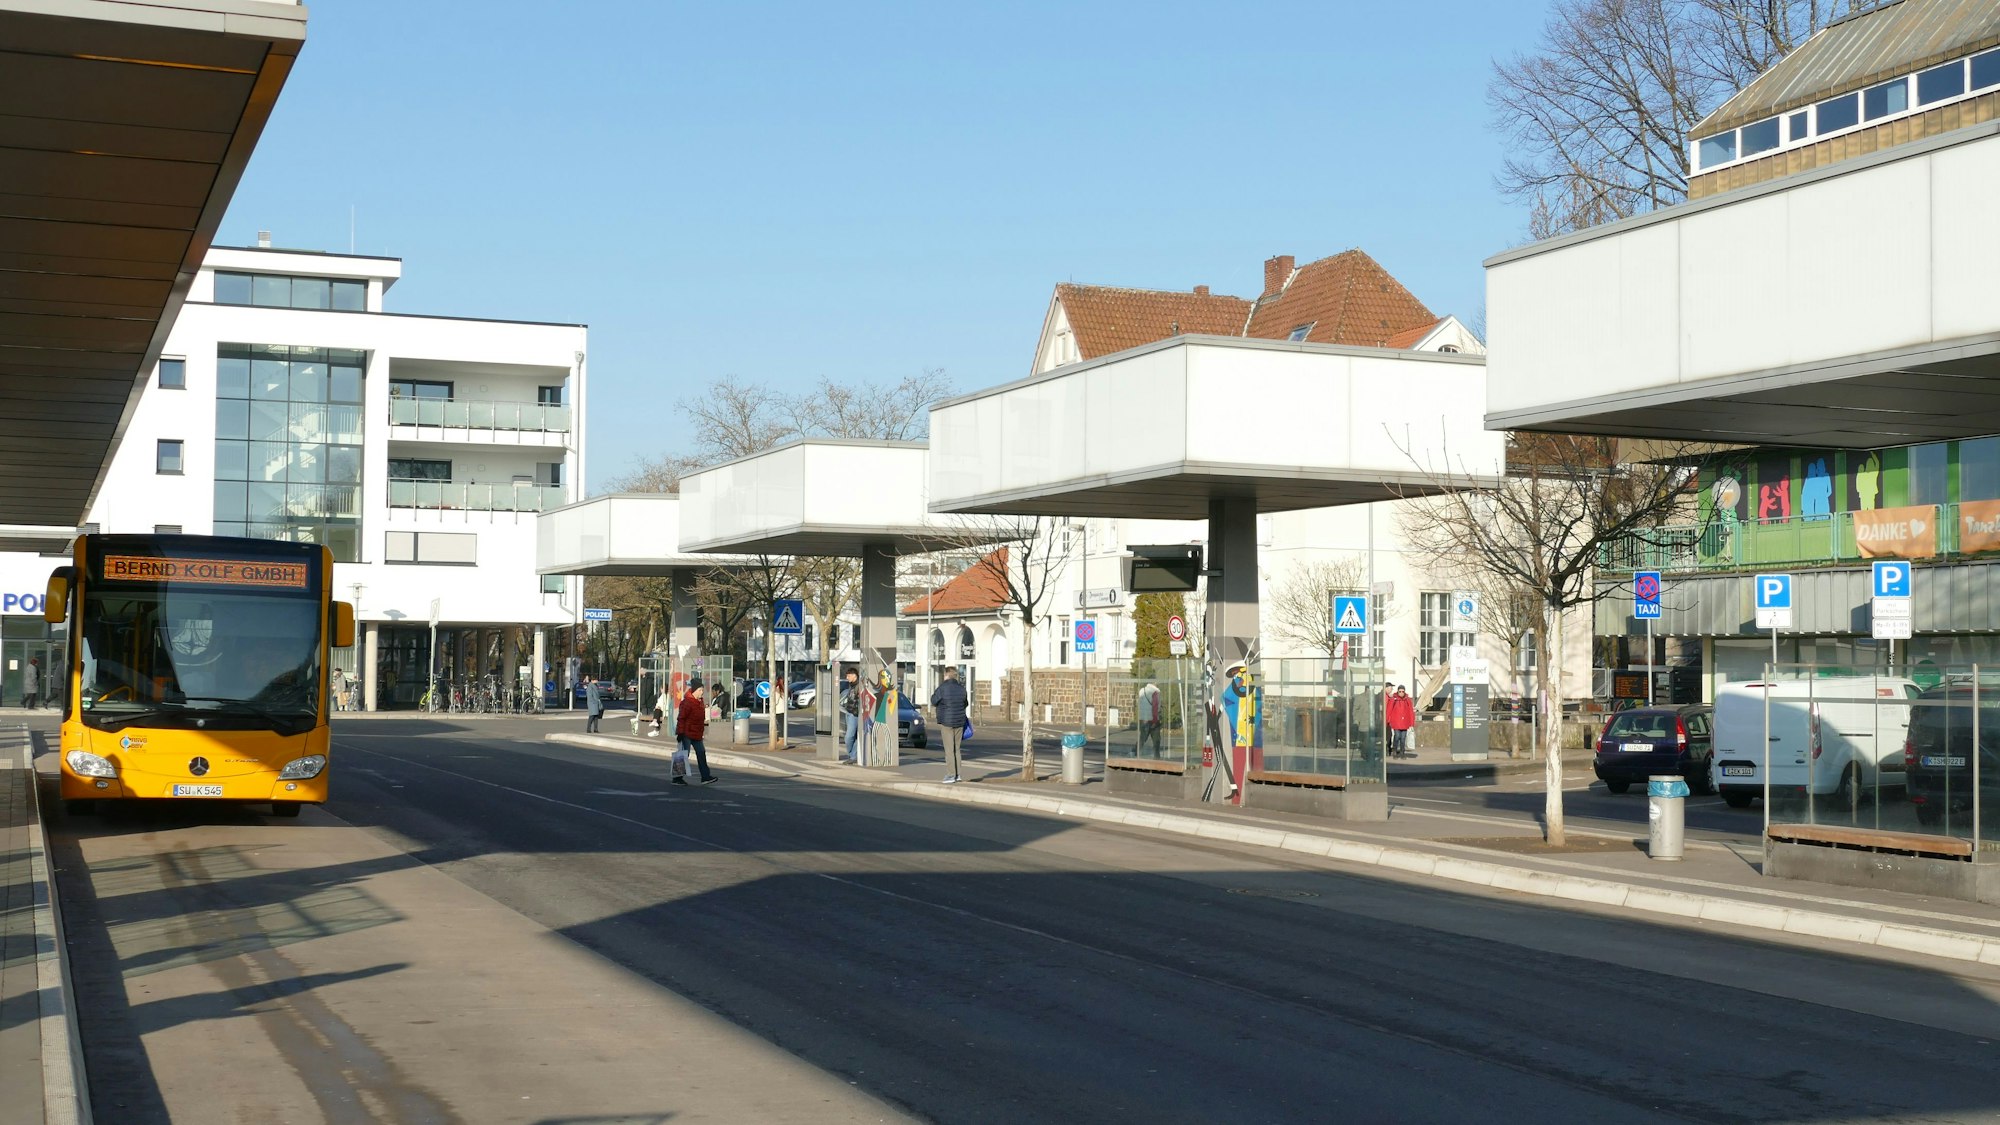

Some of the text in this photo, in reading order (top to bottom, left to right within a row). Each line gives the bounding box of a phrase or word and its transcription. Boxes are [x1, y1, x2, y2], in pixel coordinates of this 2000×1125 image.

[1857, 522, 1907, 540] DANKE
[114, 561, 296, 582] BERND KOLF GMBH
[1882, 566, 1902, 593] P
[1764, 579, 1783, 605] P
[1637, 603, 1659, 614] TAXI
[1172, 622, 1181, 634] 30
[1076, 642, 1094, 650] TAXI
[1463, 666, 1487, 674] Hennef
[179, 786, 222, 795] SU K 545
